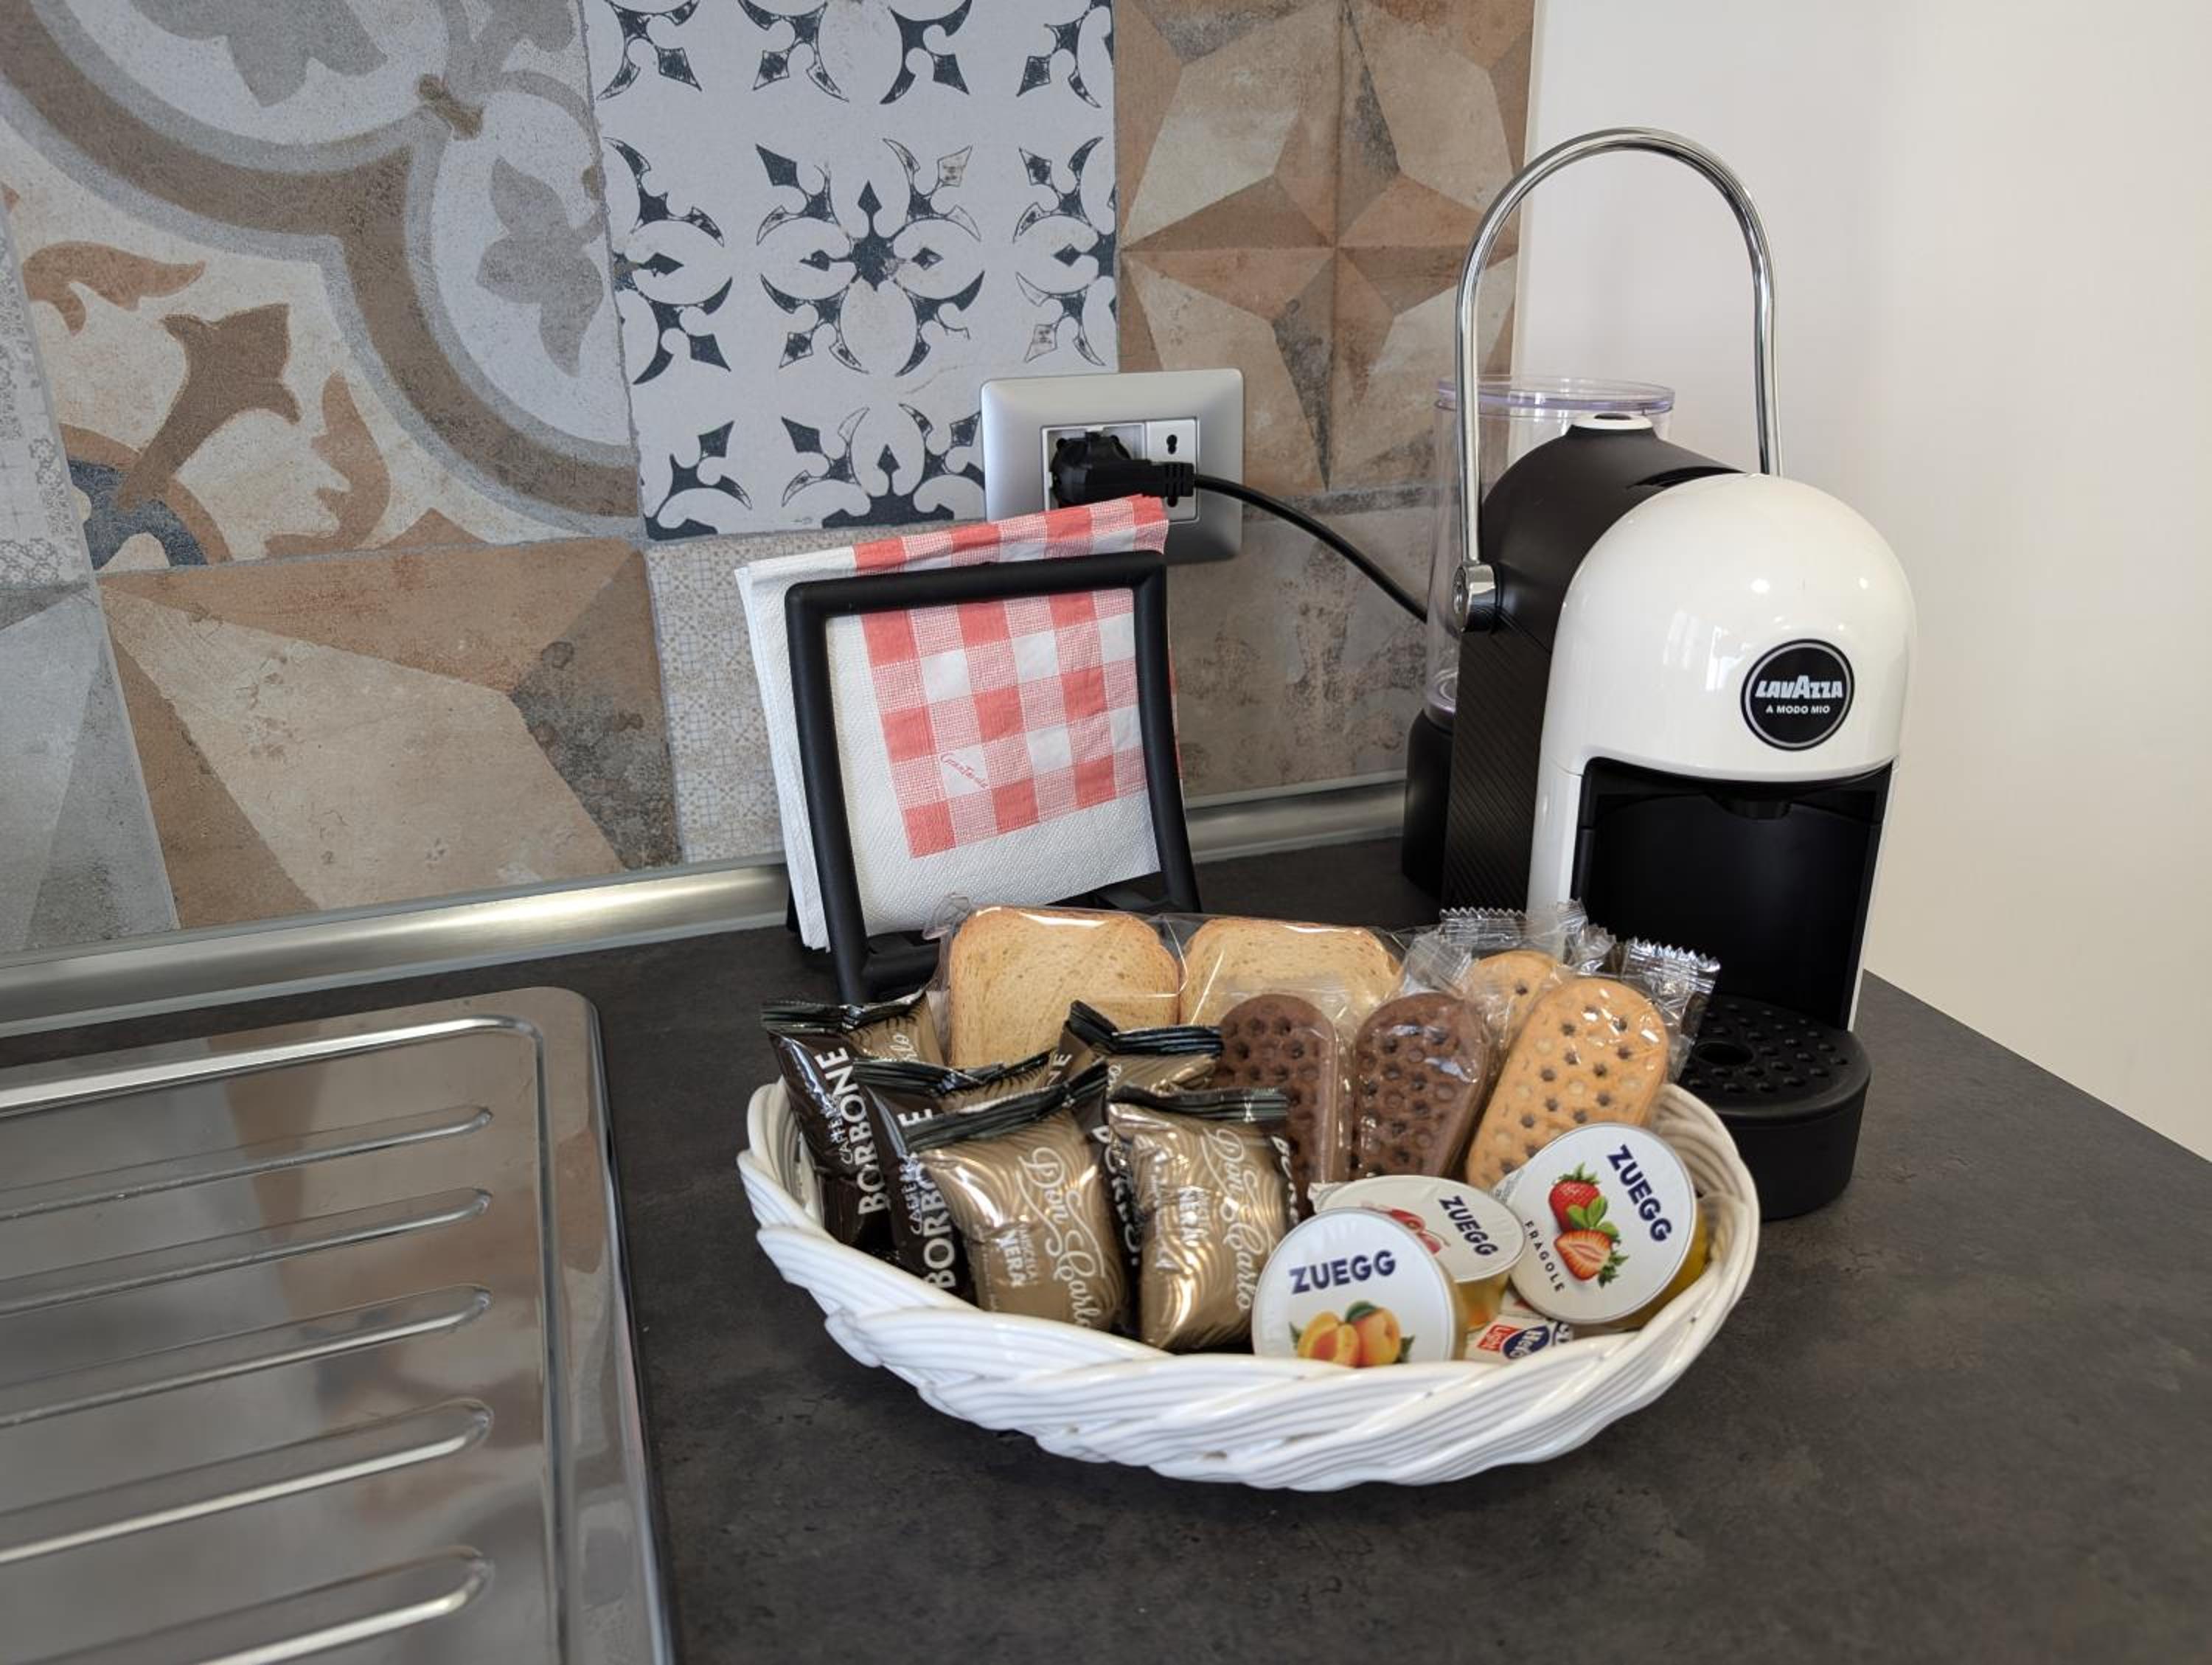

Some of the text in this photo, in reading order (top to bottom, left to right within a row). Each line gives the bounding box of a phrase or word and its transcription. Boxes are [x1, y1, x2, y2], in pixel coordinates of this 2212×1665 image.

[1755, 675, 1843, 699] LAVAZZA
[1766, 705, 1831, 715] A MODO MIO
[814, 1047, 886, 1215] BORBONE
[1607, 1144, 1672, 1242] ZUEGG
[1439, 1195, 1498, 1256] ZUEGG
[1289, 1250, 1397, 1294] ZUEGG
[1525, 1220, 1565, 1293] FRAGOLE
